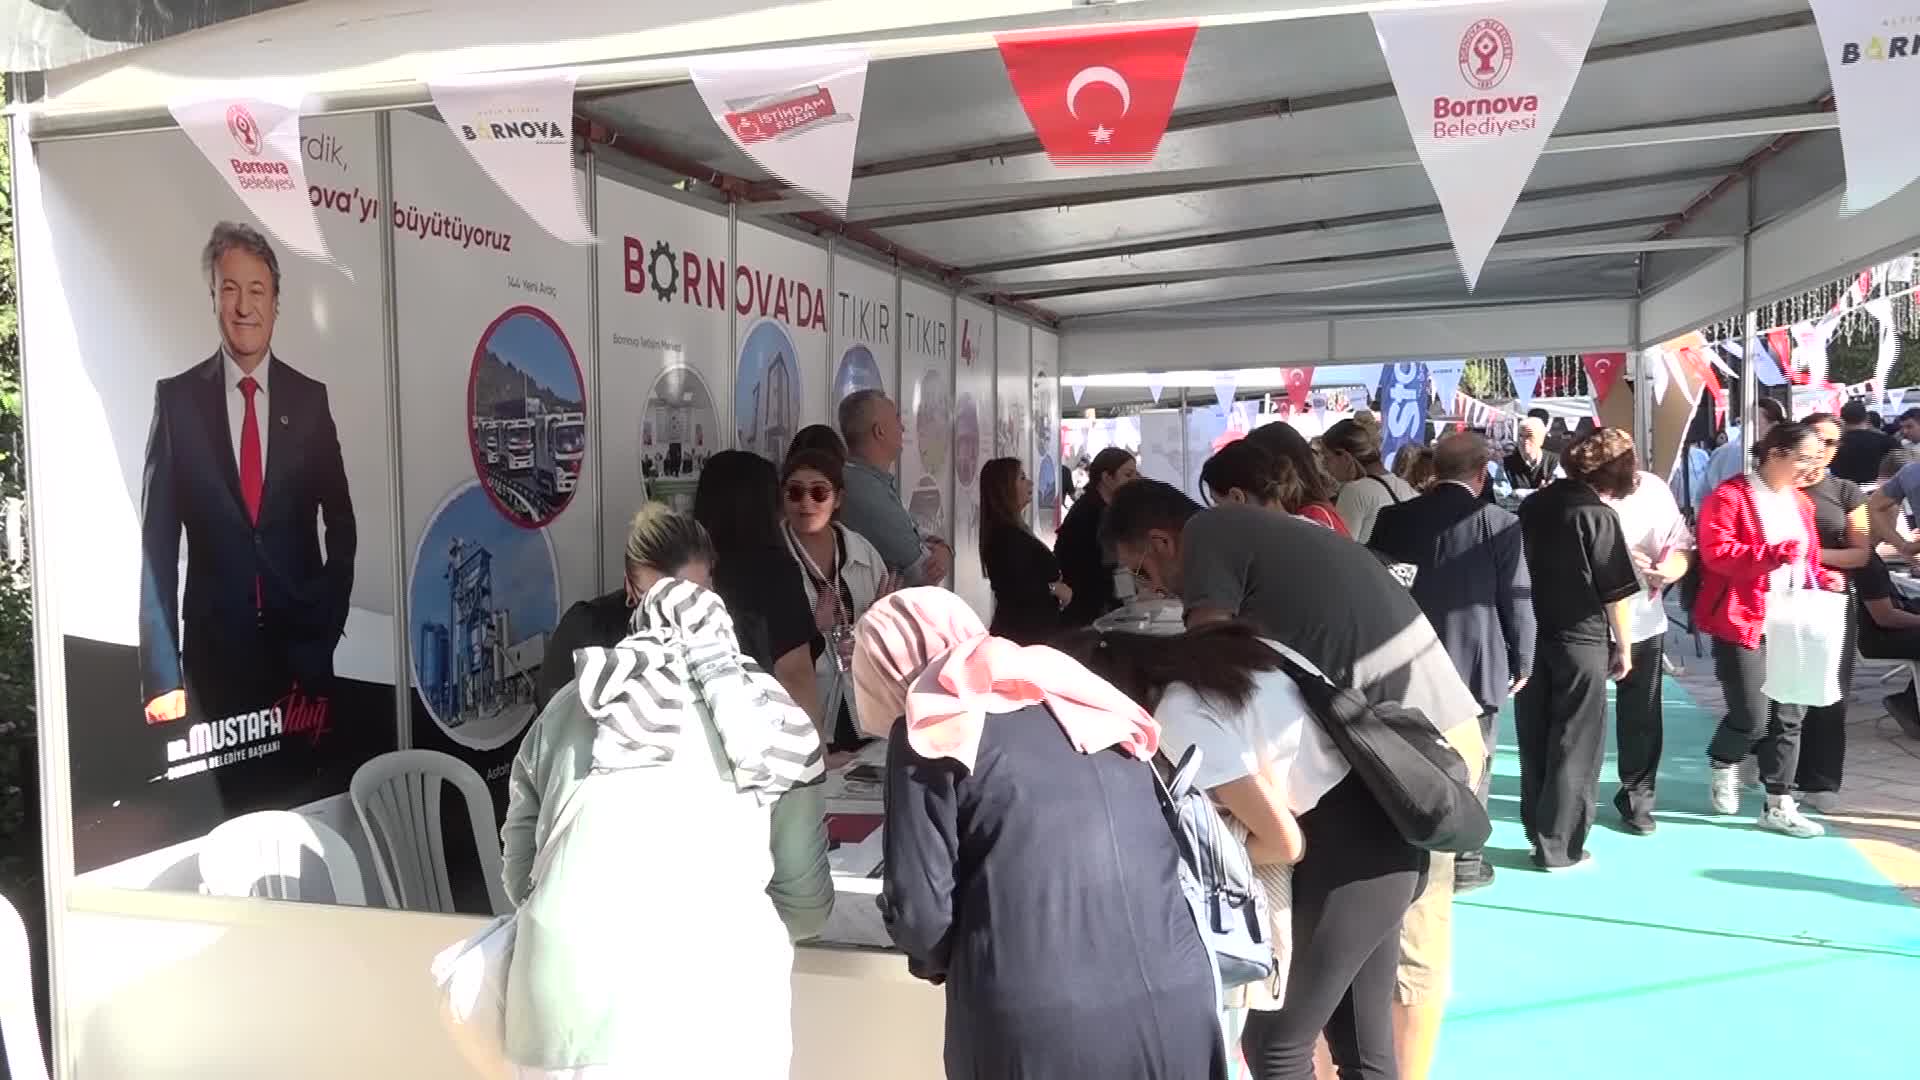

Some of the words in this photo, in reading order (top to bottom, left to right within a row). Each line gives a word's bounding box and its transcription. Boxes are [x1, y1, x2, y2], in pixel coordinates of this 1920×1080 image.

[1433, 95, 1539, 119] Bornova
[1433, 114, 1536, 139] Belediyesi
[230, 158, 289, 175] Bornova
[237, 174, 296, 191] Belediyesi
[394, 202, 513, 251] büyütüyoruz
[623, 234, 828, 333] BORNOVA'DA
[838, 291, 890, 345] TIKIR
[904, 312, 947, 361] TIKIR
[188, 706, 282, 757] MUSTAFA
